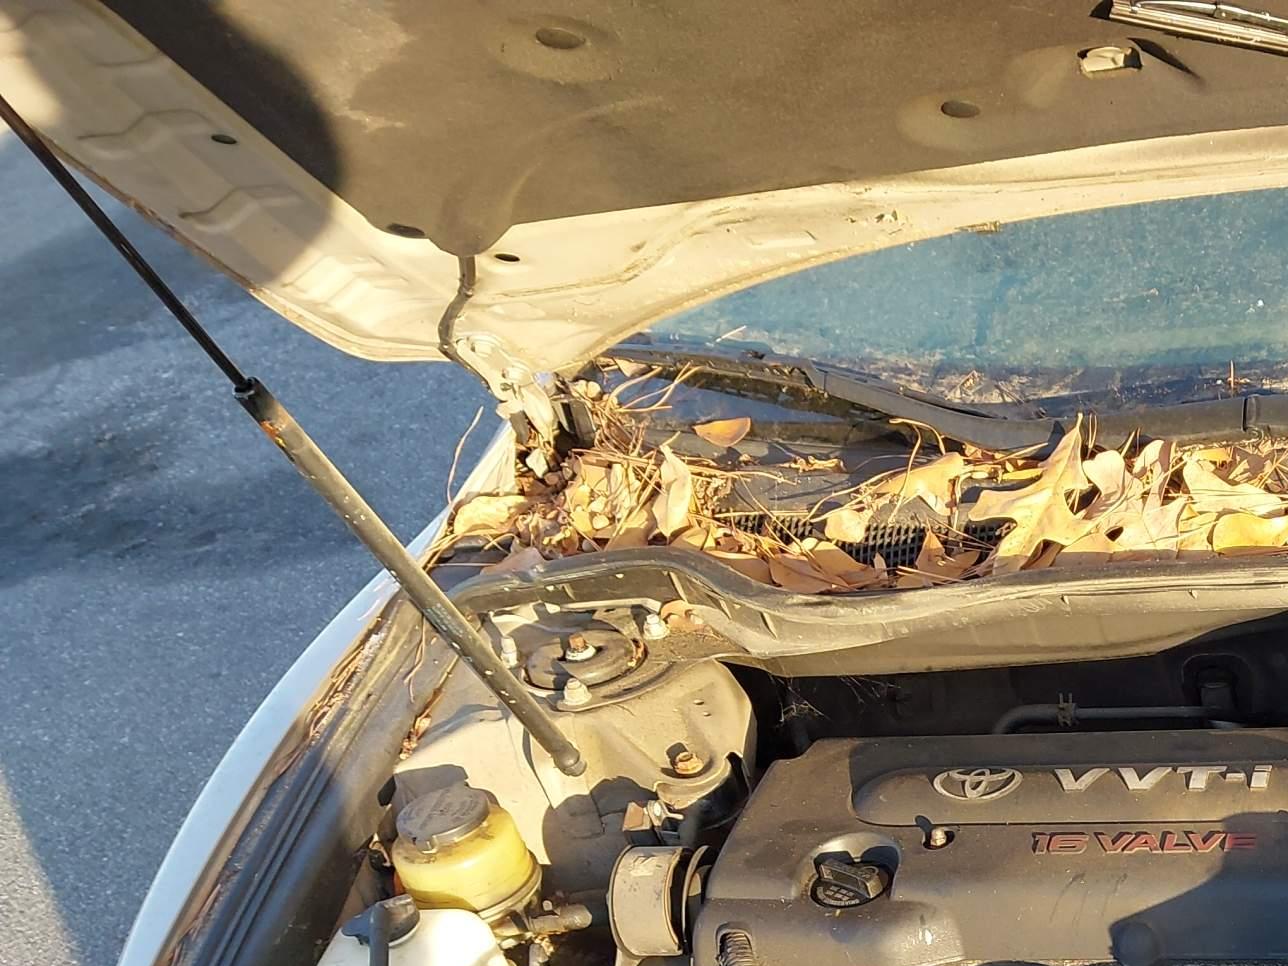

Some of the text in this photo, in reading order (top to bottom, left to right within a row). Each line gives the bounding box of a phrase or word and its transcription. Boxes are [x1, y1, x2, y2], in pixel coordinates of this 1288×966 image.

[1054, 764, 1273, 792] VVT-i
[1031, 831, 1258, 855] 16 VALVE
